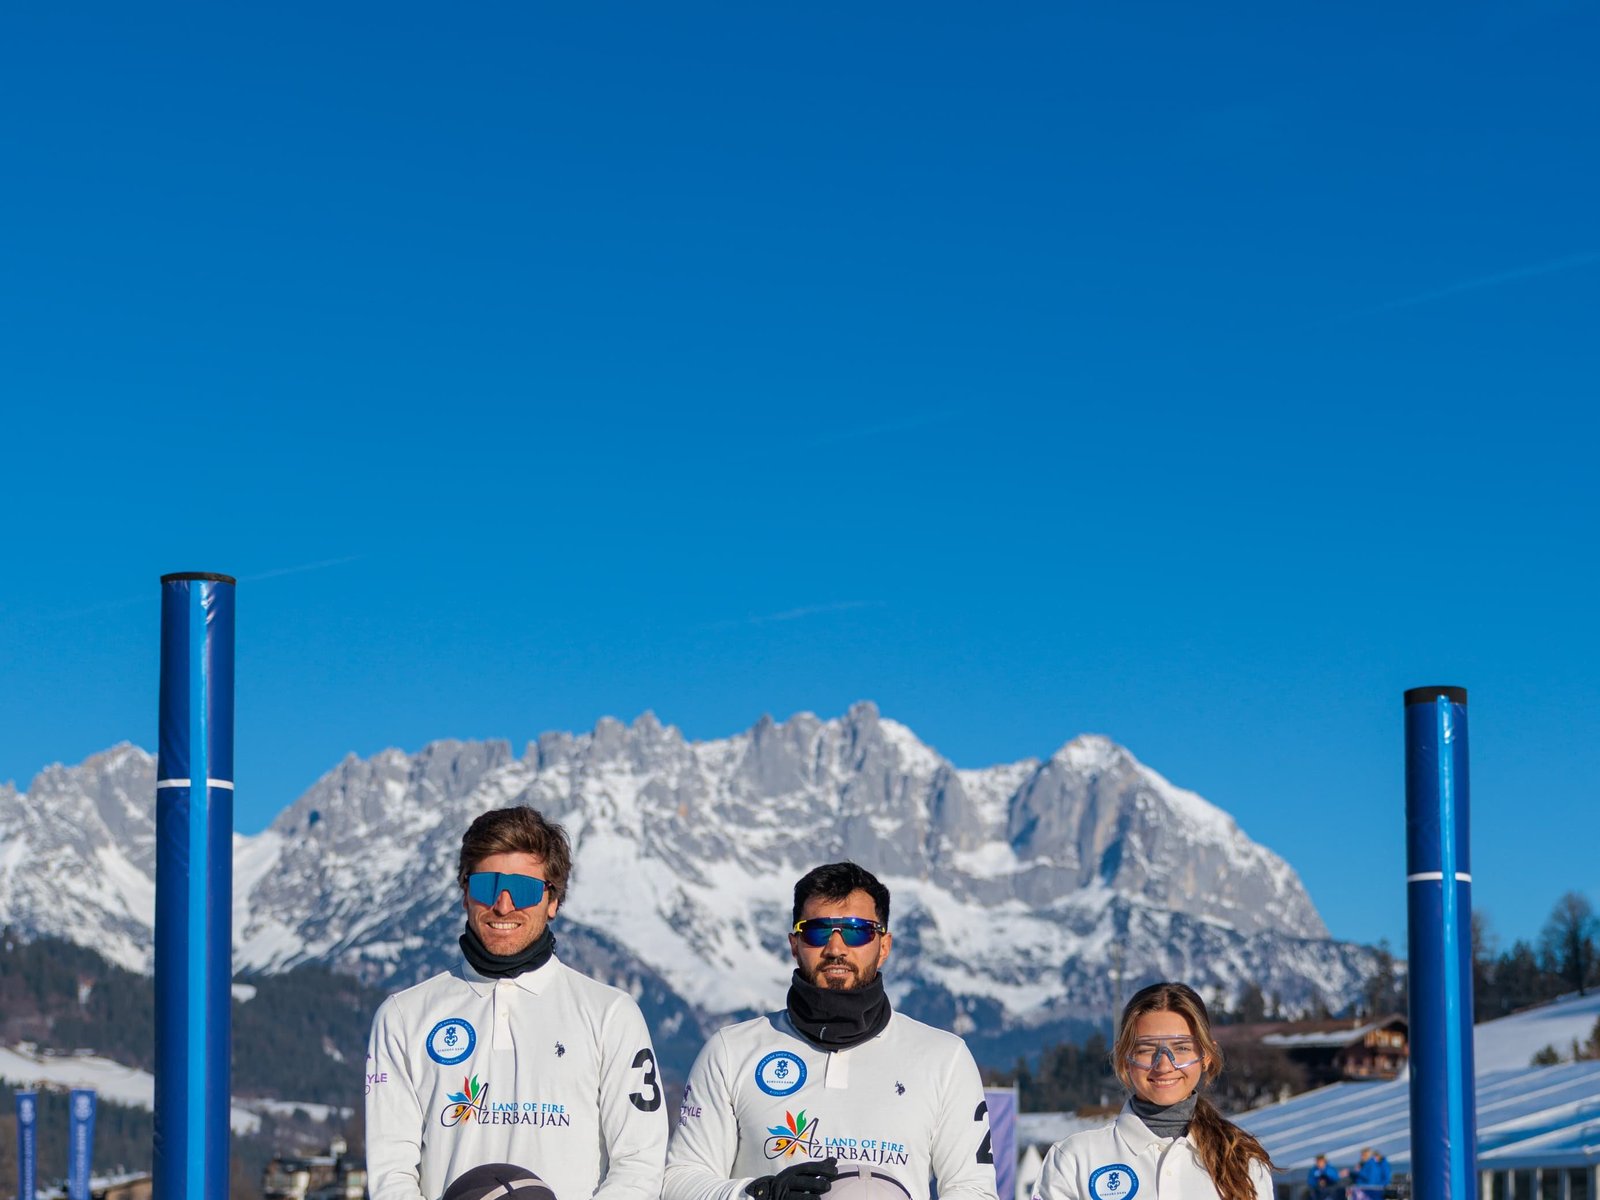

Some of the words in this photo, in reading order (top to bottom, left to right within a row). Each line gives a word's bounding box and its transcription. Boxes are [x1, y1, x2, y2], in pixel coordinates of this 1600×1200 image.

[629, 1048, 661, 1112] 3
[441, 1082, 570, 1128] AZERBAIJAN
[492, 1102, 519, 1111] LAND
[523, 1102, 537, 1112] OF
[541, 1103, 565, 1114] FIRE
[764, 1117, 909, 1165] AZERBAIJAN
[825, 1137, 856, 1147] LAND
[861, 1139, 877, 1149] OF
[881, 1141, 904, 1153] FIRE
[974, 1100, 994, 1164] 2
